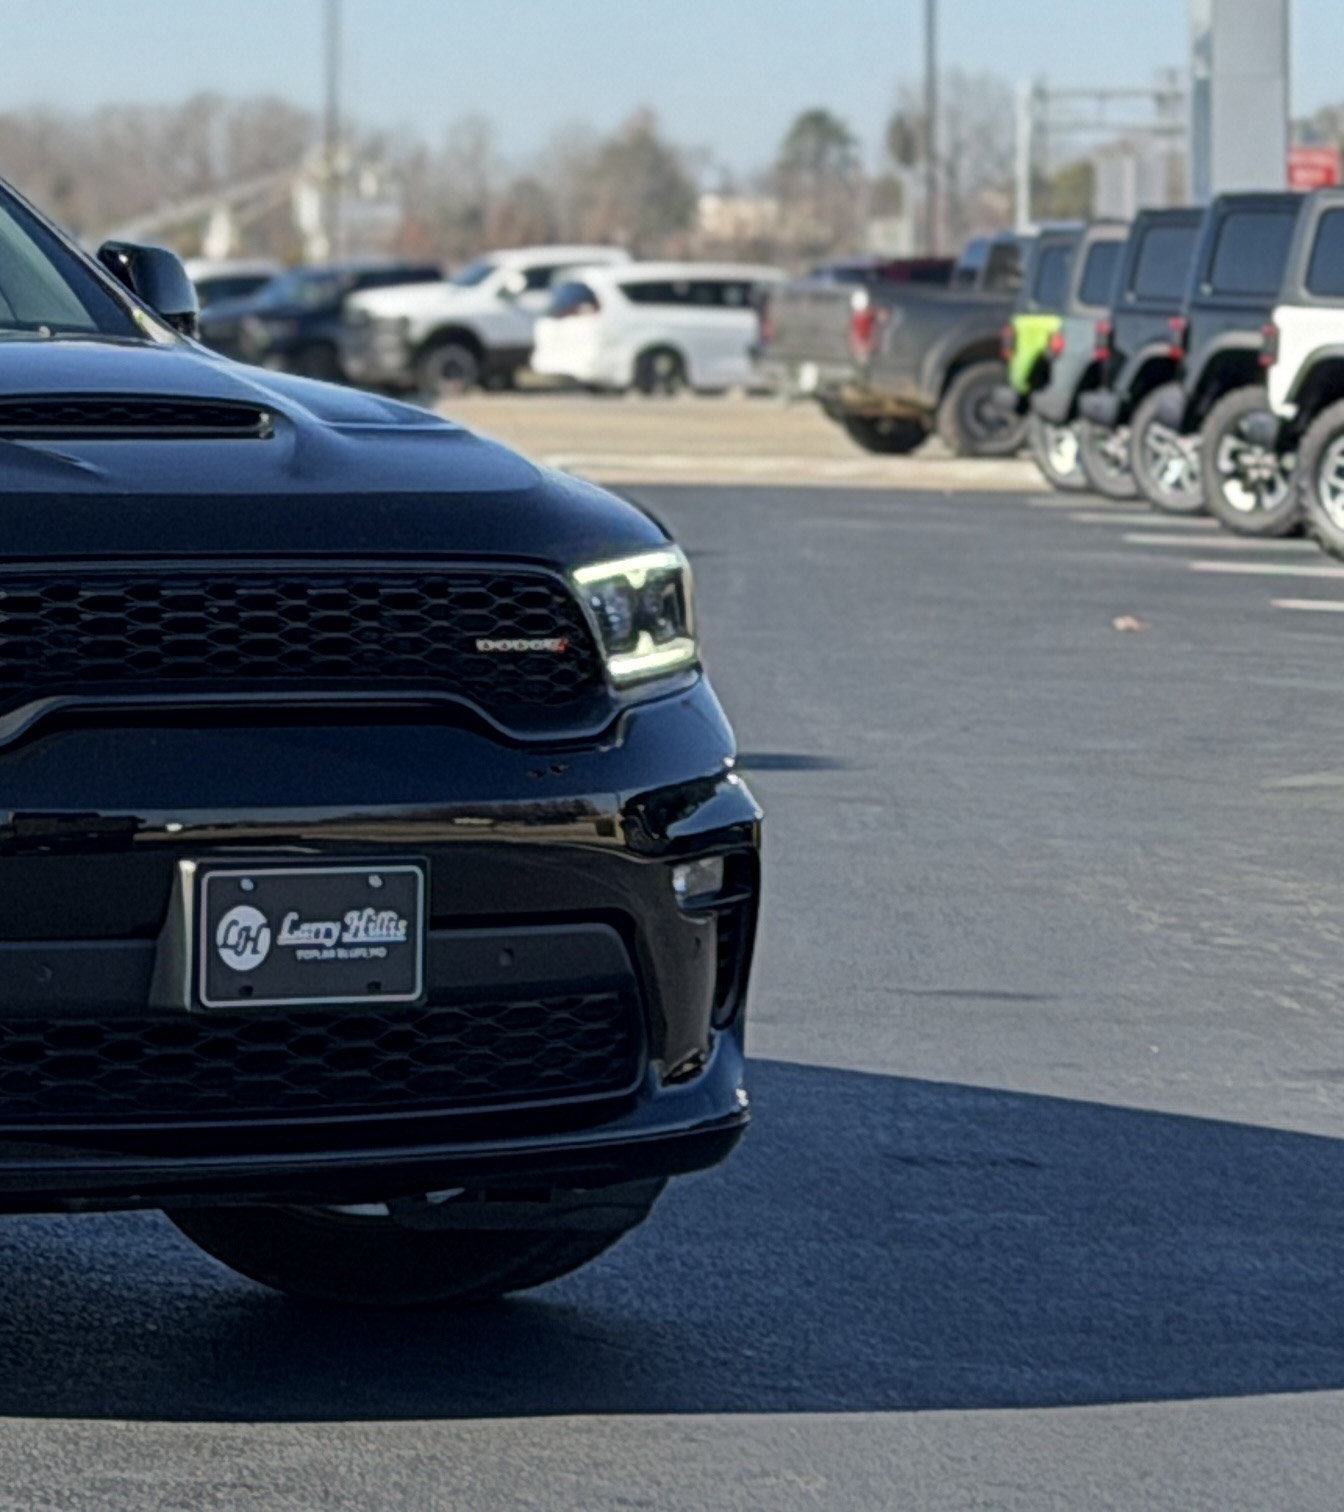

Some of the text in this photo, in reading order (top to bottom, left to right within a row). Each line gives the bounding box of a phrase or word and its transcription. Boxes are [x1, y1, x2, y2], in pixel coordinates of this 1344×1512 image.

[476, 638, 558, 653] DODGE
[276, 907, 408, 947] Larry Hillis
